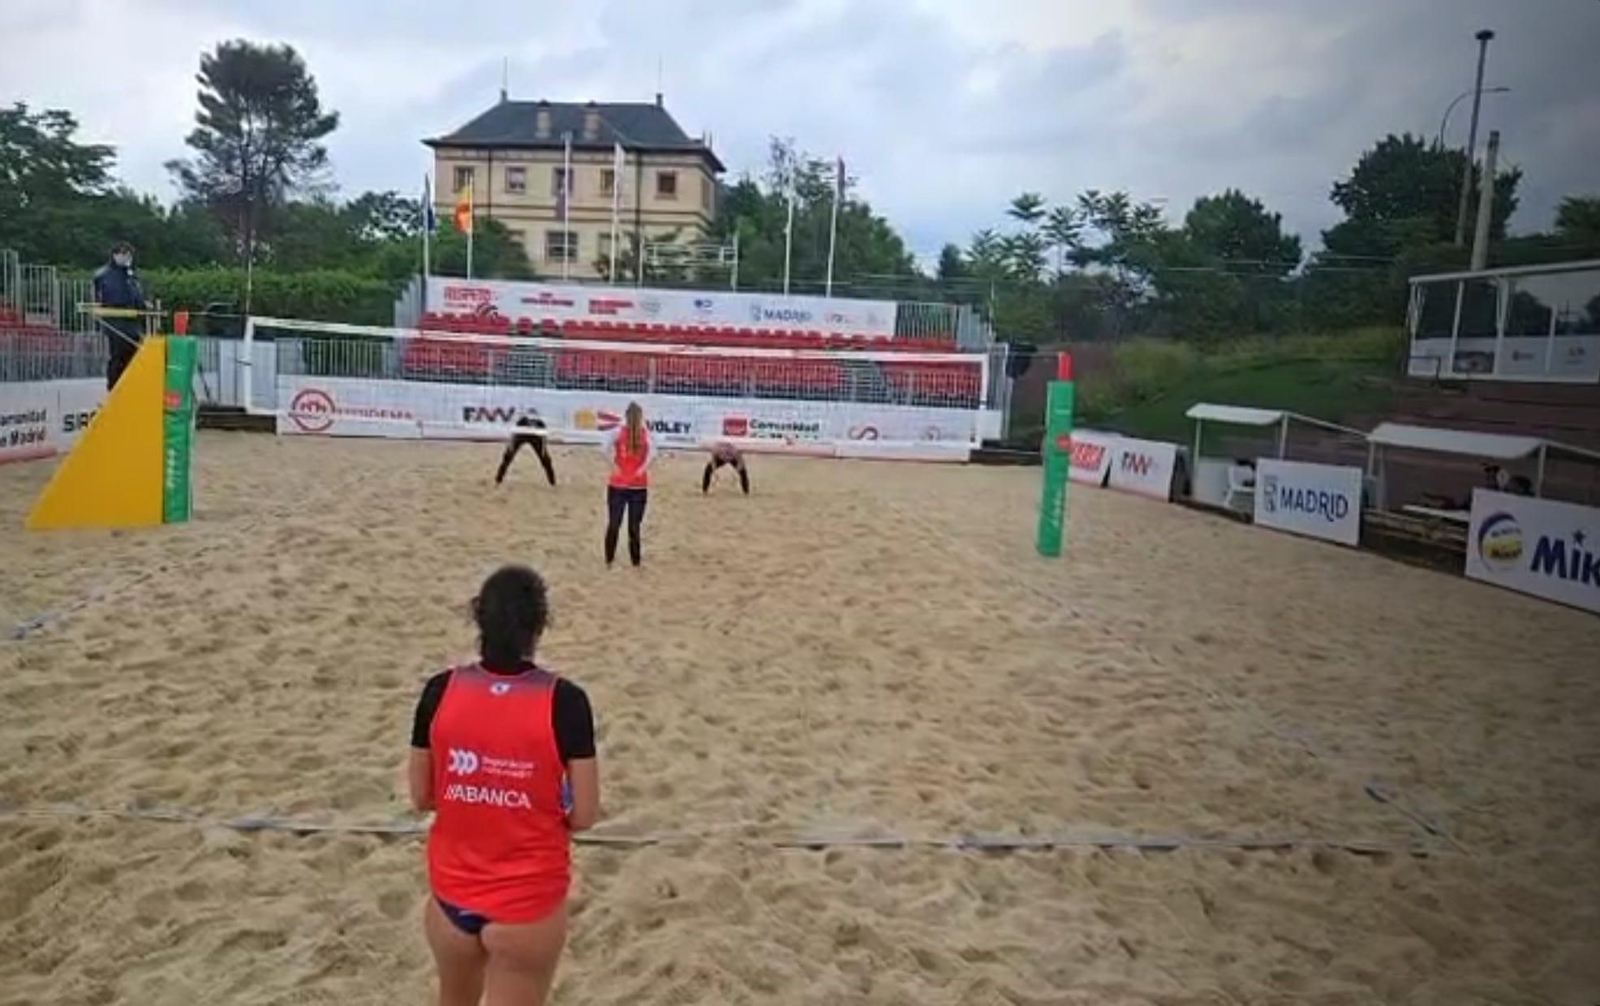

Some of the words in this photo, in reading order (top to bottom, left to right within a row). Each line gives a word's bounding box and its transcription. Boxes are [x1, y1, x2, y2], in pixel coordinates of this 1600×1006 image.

[764, 308, 812, 322] MADRID
[749, 418, 820, 432] Comunidad
[1280, 486, 1349, 522] MADRID
